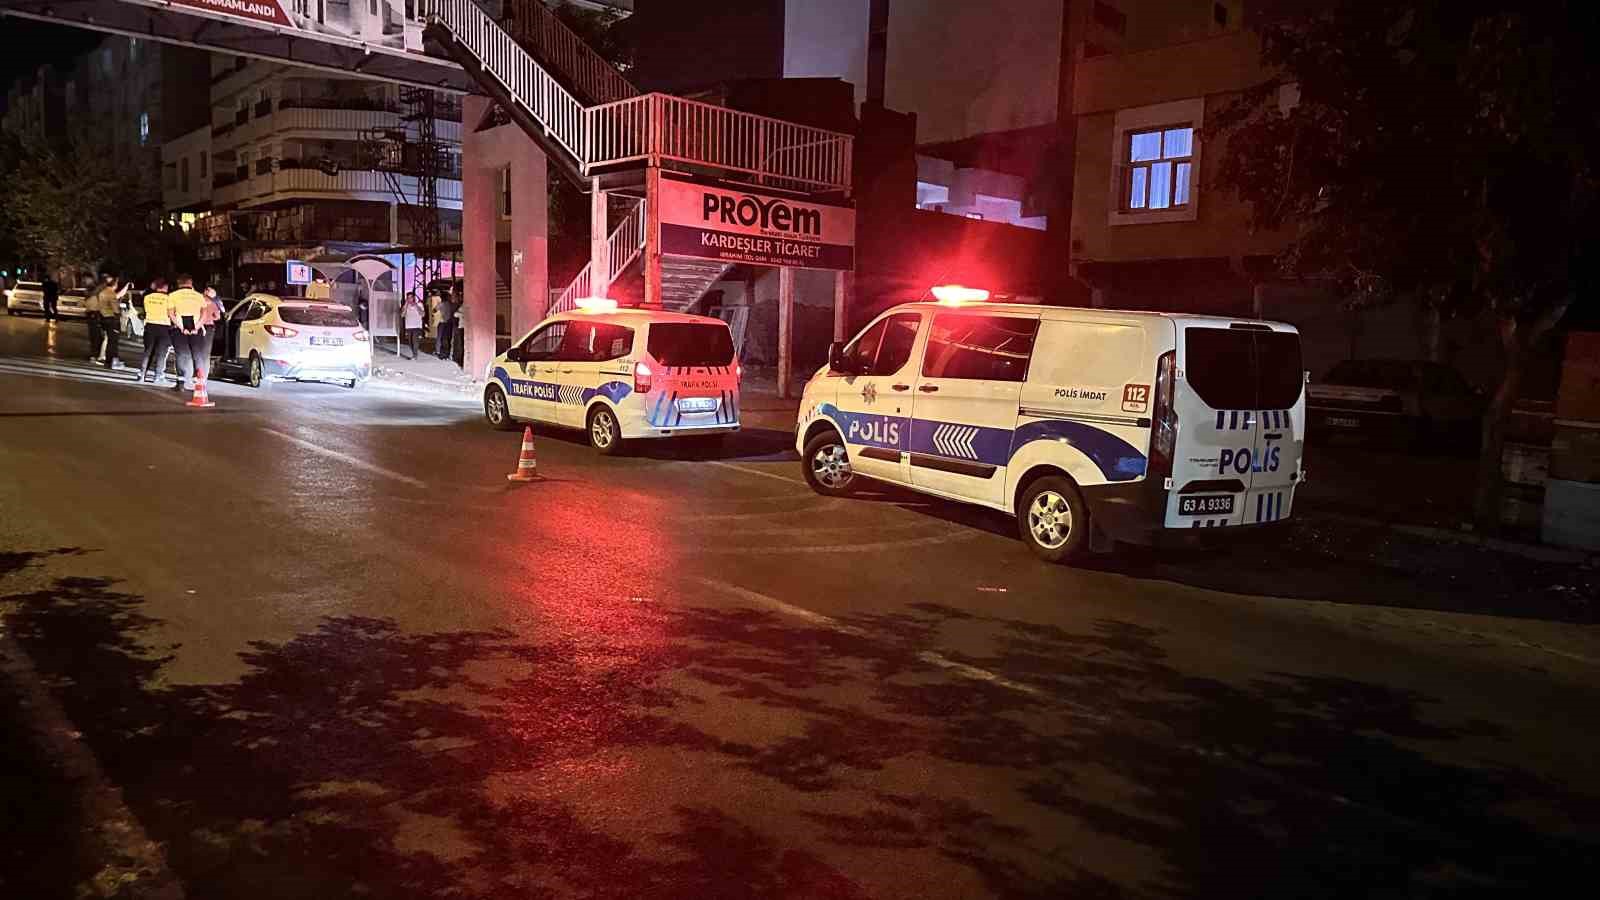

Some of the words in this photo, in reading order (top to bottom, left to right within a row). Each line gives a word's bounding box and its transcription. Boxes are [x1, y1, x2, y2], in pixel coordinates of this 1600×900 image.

[701, 231, 771, 253] KARDEŞLER
[775, 239, 821, 257] TİCARET
[511, 382, 533, 396] TRAFİK
[534, 385, 555, 399] POLİSİ
[1054, 388, 1078, 398] POLİS
[1079, 388, 1107, 400] İMDAT
[1127, 386, 1146, 401] 112
[849, 417, 899, 444] POLİS
[1219, 441, 1280, 474] POLİS
[1183, 500, 1196, 511] 63
[1198, 499, 1206, 510] A
[1208, 498, 1231, 510] 9336
